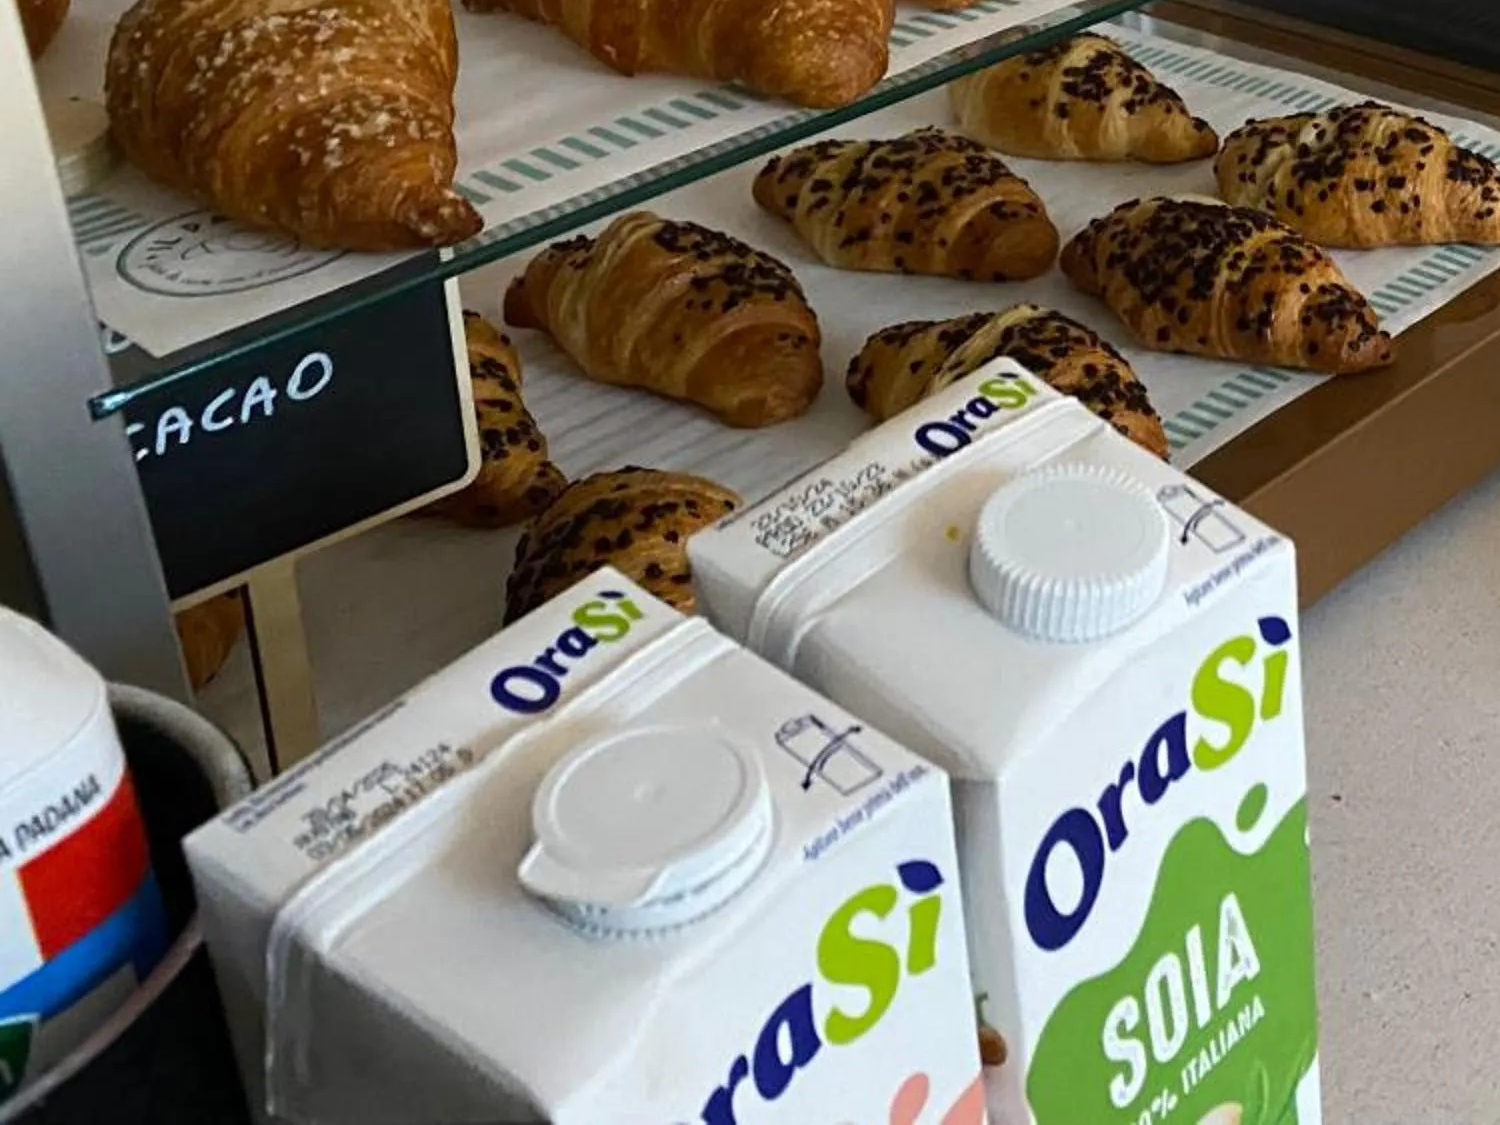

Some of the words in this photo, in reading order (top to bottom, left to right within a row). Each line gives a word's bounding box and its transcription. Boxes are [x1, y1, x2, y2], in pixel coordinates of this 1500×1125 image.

[14, 774, 102, 851] PADANA
[1102, 889, 1261, 1109] SOIA
[1181, 993, 1266, 1095] ITALIANA
